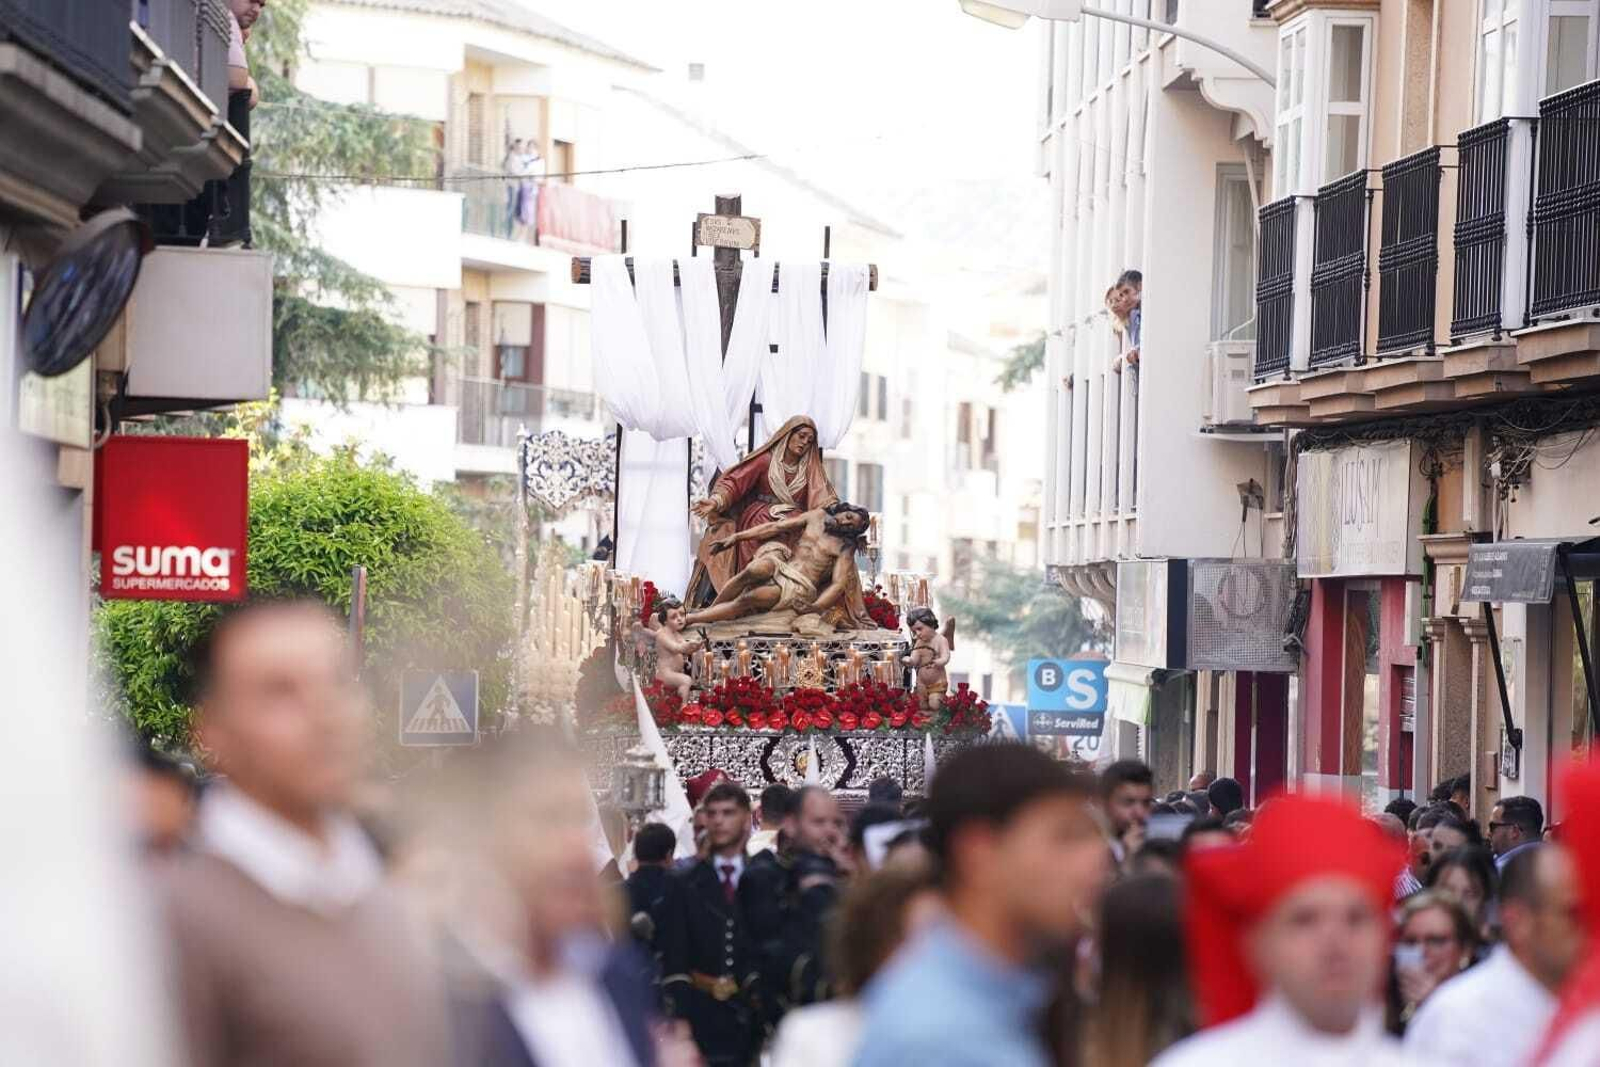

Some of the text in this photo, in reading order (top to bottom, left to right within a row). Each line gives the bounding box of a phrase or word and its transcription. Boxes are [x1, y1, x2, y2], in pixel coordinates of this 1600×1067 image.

[112, 545, 231, 577] suma
[113, 577, 231, 591] SUPERMERCADOS
[1041, 668, 1098, 709] B S
[1054, 717, 1099, 729] ServiRed
